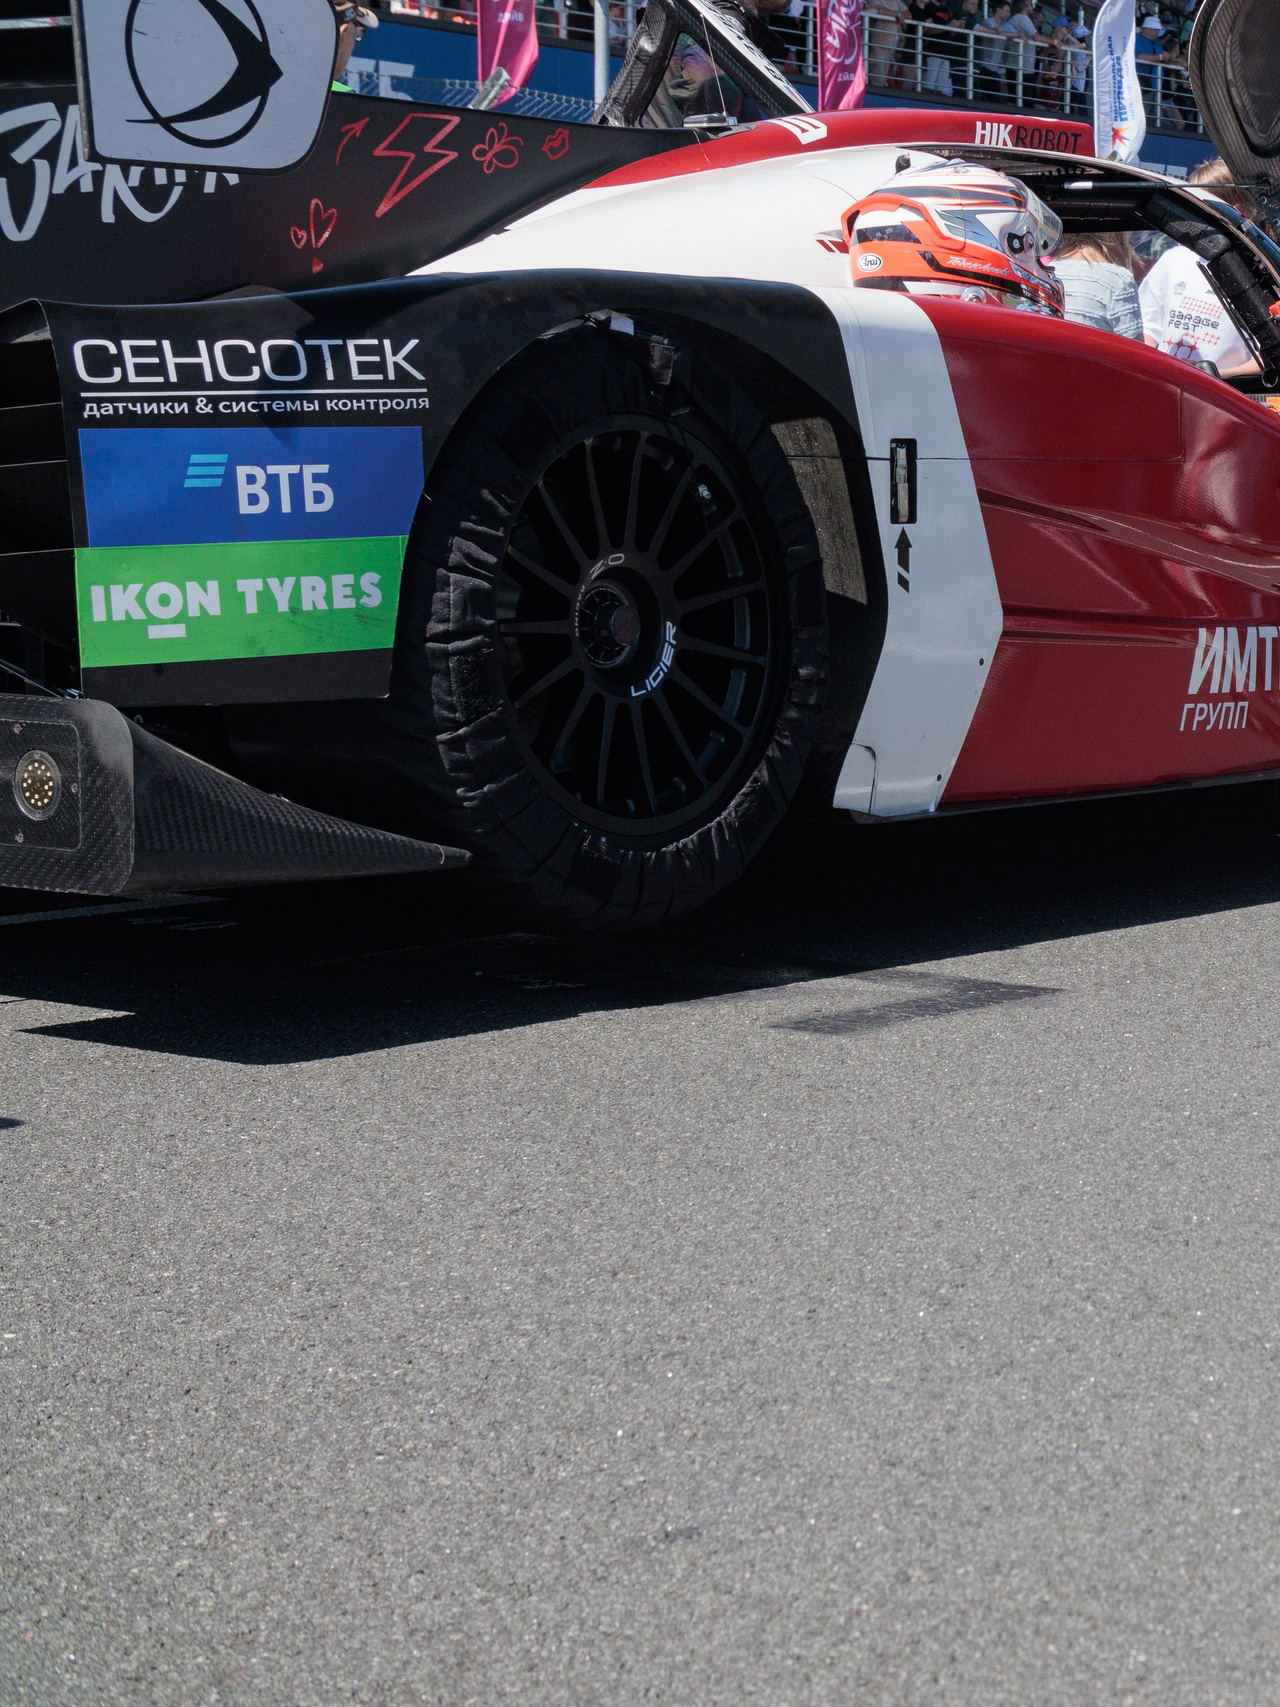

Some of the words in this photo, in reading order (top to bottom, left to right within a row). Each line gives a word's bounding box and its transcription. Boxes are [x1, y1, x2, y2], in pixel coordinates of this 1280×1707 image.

[346, 55, 416, 102] ТБ
[1115, 55, 1129, 123] ПРАВДА
[974, 120, 1083, 155] HIKROBOT
[863, 255, 879, 266] Arai
[72, 338, 427, 384] СЕНСОТЕК
[83, 399, 189, 418] датчики
[195, 396, 214, 414] &
[218, 397, 320, 414] системы
[326, 395, 430, 414] контроля
[235, 463, 335, 515] ВТБ
[90, 579, 222, 624] IKON
[236, 571, 383, 615] TYRES
[630, 620, 678, 697] LIGIER
[1179, 701, 1249, 732] ГРУПП
